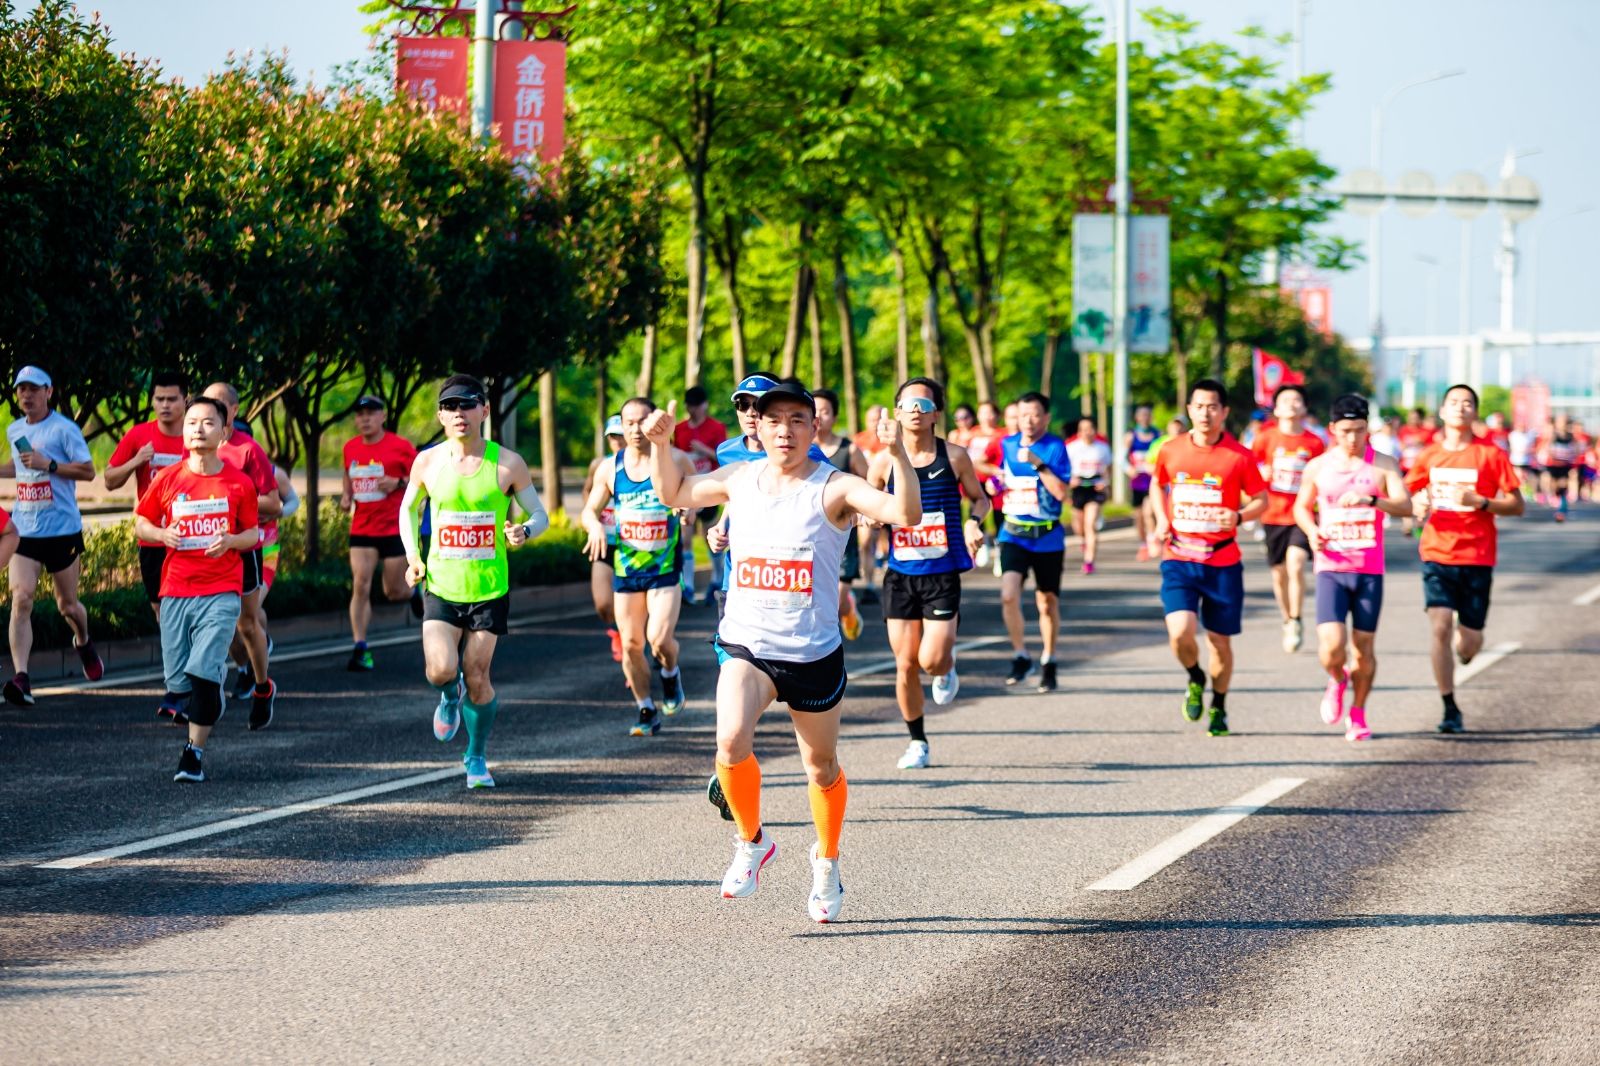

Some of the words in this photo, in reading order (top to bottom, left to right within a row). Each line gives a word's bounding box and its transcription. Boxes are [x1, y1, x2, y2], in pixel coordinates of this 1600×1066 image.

[17, 485, 52, 500] C10838
[177, 516, 229, 536] C10603
[621, 524, 667, 540] C10877
[440, 528, 494, 546] C10613
[894, 529, 946, 546] C10148
[738, 562, 811, 589] C10810
